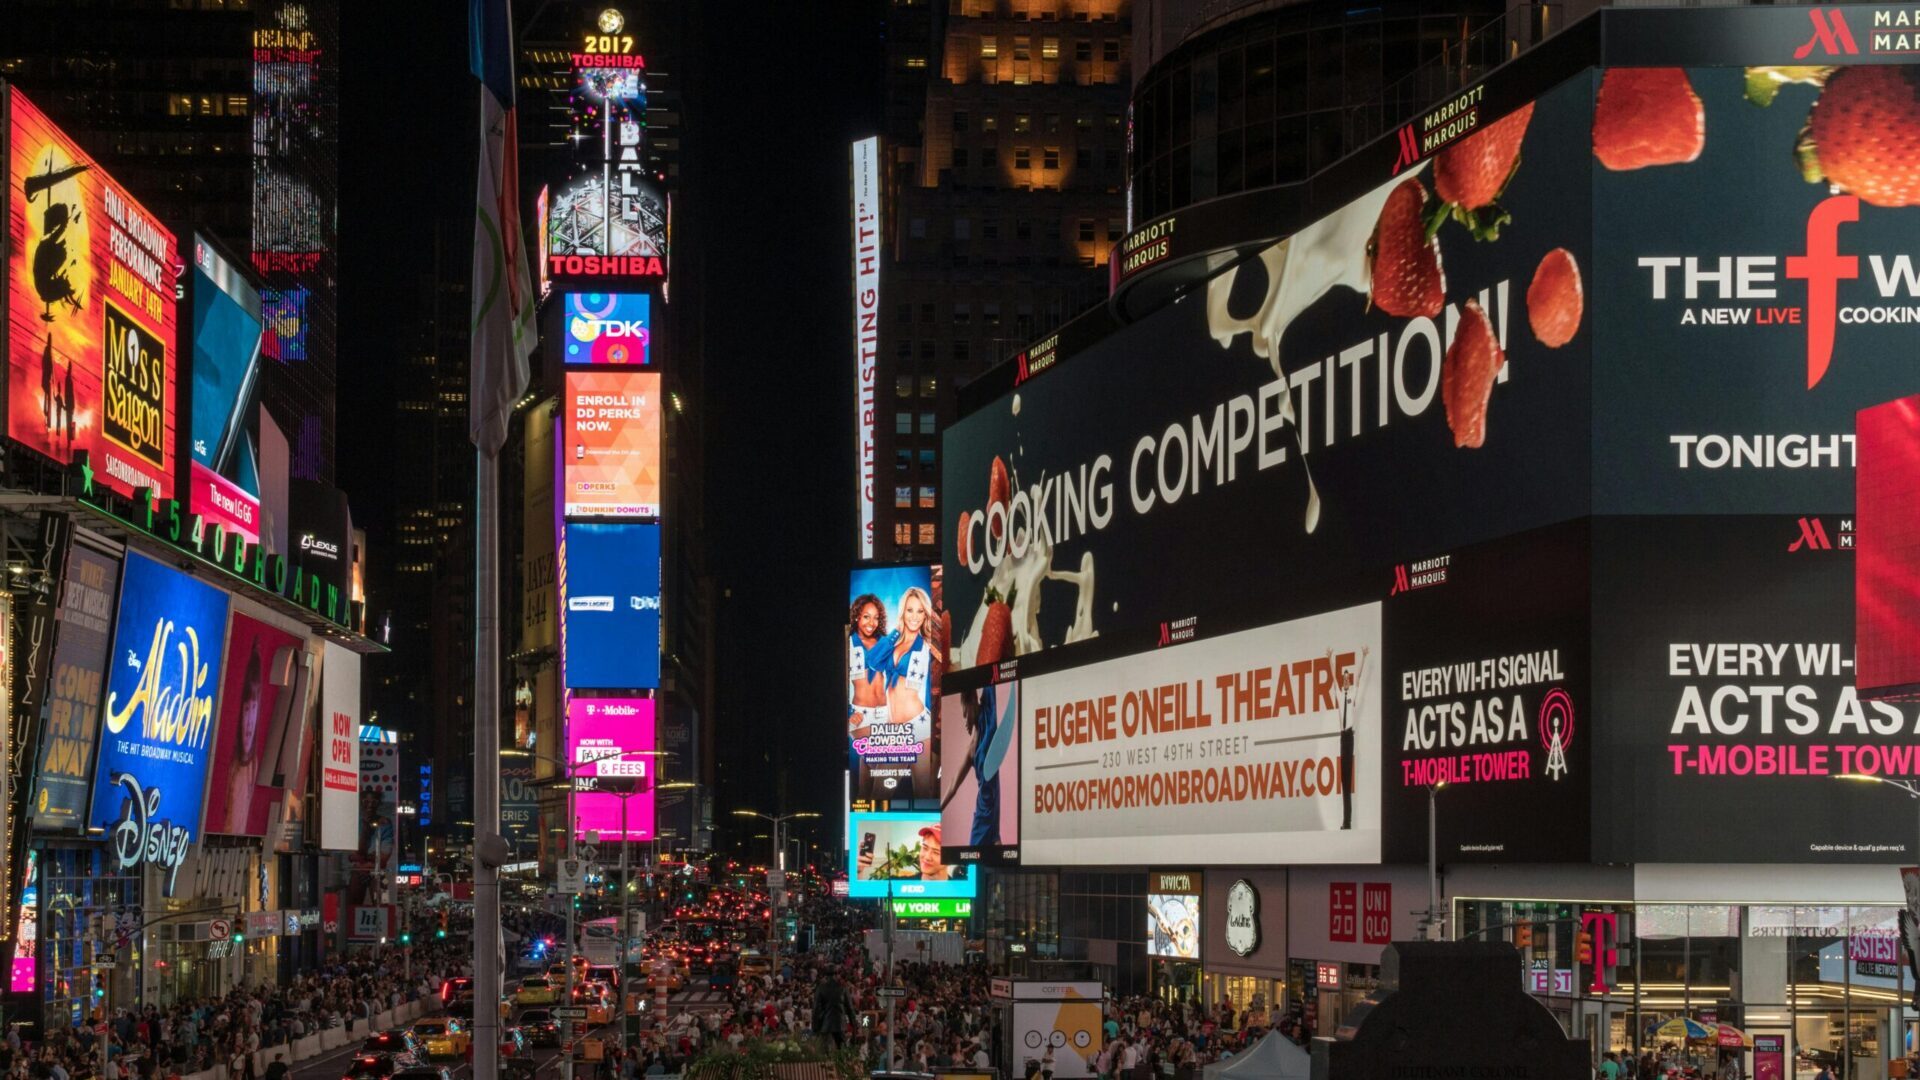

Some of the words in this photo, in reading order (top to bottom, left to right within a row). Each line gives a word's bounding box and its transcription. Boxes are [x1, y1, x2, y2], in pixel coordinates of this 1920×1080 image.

[585, 36, 634, 53] 2017
[572, 54, 645, 68] TOSHIBA
[1424, 85, 1484, 131] MARRIOTT
[1424, 112, 1477, 152] MARQUIS
[618, 122, 642, 221] BALL
[104, 185, 127, 230] FINAL
[128, 207, 167, 264] BROADWAY
[1122, 218, 1176, 254] MARRIOTT
[110, 223, 162, 293] PERFORMANCE
[550, 256, 663, 276] TOSHIBA
[1122, 241, 1168, 276] MARQUIS
[1638, 256, 1777, 299] THE
[109, 258, 144, 309] JANUARY
[146, 287, 162, 324] 14TH
[1680, 308, 1697, 325] A
[1701, 308, 1752, 325] NEW
[1755, 308, 1801, 324] LIVE
[1838, 306, 1920, 325] COOKIN
[590, 320, 643, 338] TDK
[1030, 335, 1059, 358] MARRIOTT
[1030, 351, 1056, 374] MARQUIS
[108, 368, 161, 452] Saigon
[576, 395, 628, 406] ENROLL
[632, 395, 646, 406] IN
[576, 408, 595, 419] DD
[599, 408, 641, 419] PERKS
[576, 421, 612, 432] NOW.
[210, 483, 222, 507] The
[222, 493, 234, 513] new
[234, 496, 244, 519] LG
[243, 502, 252, 525] G6
[617, 506, 650, 514] DONUTS
[966, 453, 1113, 575] COOKING
[144, 487, 225, 563] 1540
[311, 539, 338, 553] LEXUS
[1411, 554, 1451, 573] MARRIOTT
[1411, 570, 1446, 588] MARQUIS
[1171, 616, 1197, 630] MARRIOTT
[1171, 629, 1194, 641] MARQUIS
[1000, 659, 1018, 671] MARRIOTT
[1669, 643, 1789, 677] EVERY
[56, 663, 101, 706] COME
[106, 617, 213, 750] Aladdin
[1000, 669, 1017, 679] MARQUIS
[1402, 664, 1453, 701] EVERY
[1455, 658, 1496, 694] WI-FI
[1498, 648, 1564, 689] SIGNAL
[1034, 691, 1117, 750] EUGENE
[1121, 676, 1212, 741] O'NEILL
[1670, 684, 1820, 735] ACTS
[1828, 684, 1905, 735] AS
[333, 711, 351, 738] NOW
[870, 723, 912, 735] DALLAS
[1403, 697, 1467, 752] ACTS
[1469, 696, 1505, 747] AS
[1508, 694, 1528, 742] A
[332, 738, 351, 764] OPEN
[580, 738, 596, 746] NOW
[597, 738, 614, 746] WITH
[853, 737, 923, 755] Cheerleaders
[868, 735, 914, 746] COWBOYS
[43, 735, 92, 778] AWAY
[117, 740, 129, 754] THE
[130, 743, 140, 757] HIT
[141, 745, 171, 761] BROADWAY
[172, 750, 194, 765] MUSICAL
[1101, 752, 1122, 770] 230
[1126, 747, 1158, 766] WEST
[1163, 742, 1194, 762] 49TH
[1199, 735, 1250, 759] STREET
[1667, 744, 1830, 776] T-MOBILE
[601, 763, 609, 775] &
[612, 763, 642, 775] FEES
[870, 769, 897, 777] THURSDAYS
[1401, 754, 1471, 787] T-MOBILE
[1472, 749, 1530, 782] TOWER
[1835, 843, 1853, 851] device
[1876, 843, 1889, 853] plan
[901, 884, 925, 893] #EXO
[1160, 874, 1191, 891] INVICTA
[908, 902, 940, 913] YORK
[1366, 890, 1387, 912] UNI
[1365, 916, 1389, 940] QLO
